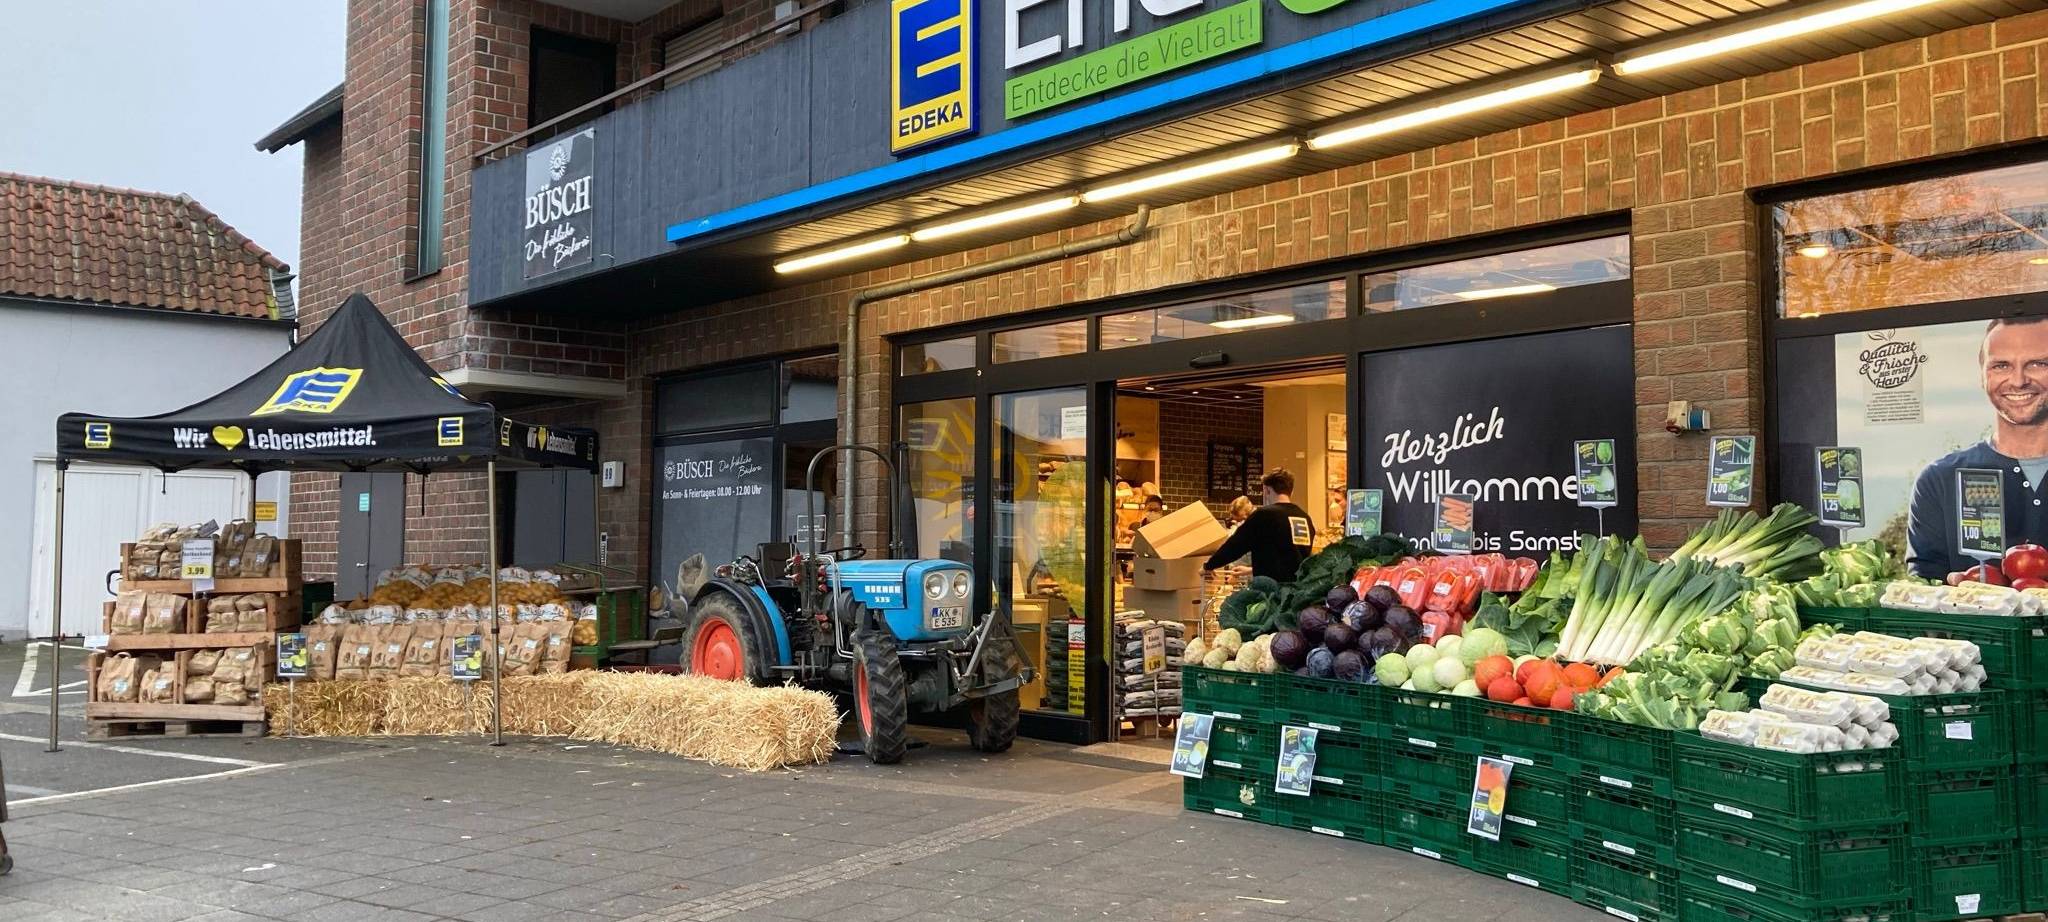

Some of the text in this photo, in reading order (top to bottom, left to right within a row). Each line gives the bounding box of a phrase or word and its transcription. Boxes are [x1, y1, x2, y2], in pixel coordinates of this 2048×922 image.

[1011, 61, 1108, 112] Entdecke
[1116, 47, 1150, 79] die
[1158, 7, 1255, 64] Vielfalt!
[899, 101, 963, 137] EDEKA
[525, 176, 591, 230] BÜSCH
[1860, 341, 1917, 363] Qualität
[1859, 353, 1928, 375] & Frische
[1879, 366, 1912, 378] aus erster
[1874, 373, 1910, 388] Hand
[173, 424, 377, 450] Wir Lebensmittel.
[1381, 407, 1505, 468] Herzlich
[676, 459, 714, 480] BÜSCH
[662, 490, 670, 500] An
[670, 488, 683, 499] Sonn-
[684, 488, 688, 498] &
[689, 487, 716, 500] Feiertagen:
[717, 486, 732, 498] 08.00
[736, 485, 751, 497] 12.00
[751, 484, 762, 495] Uhr
[1386, 469, 1578, 504] Willkomme
[1823, 499, 1839, 512] 1,25
[1472, 531, 1502, 551] bis
[1509, 530, 1610, 551] Samst
[1963, 526, 1980, 541] 1,00
[187, 566, 205, 576] 3.99
[934, 616, 957, 627] E 535
[940, 608, 950, 618] KK
